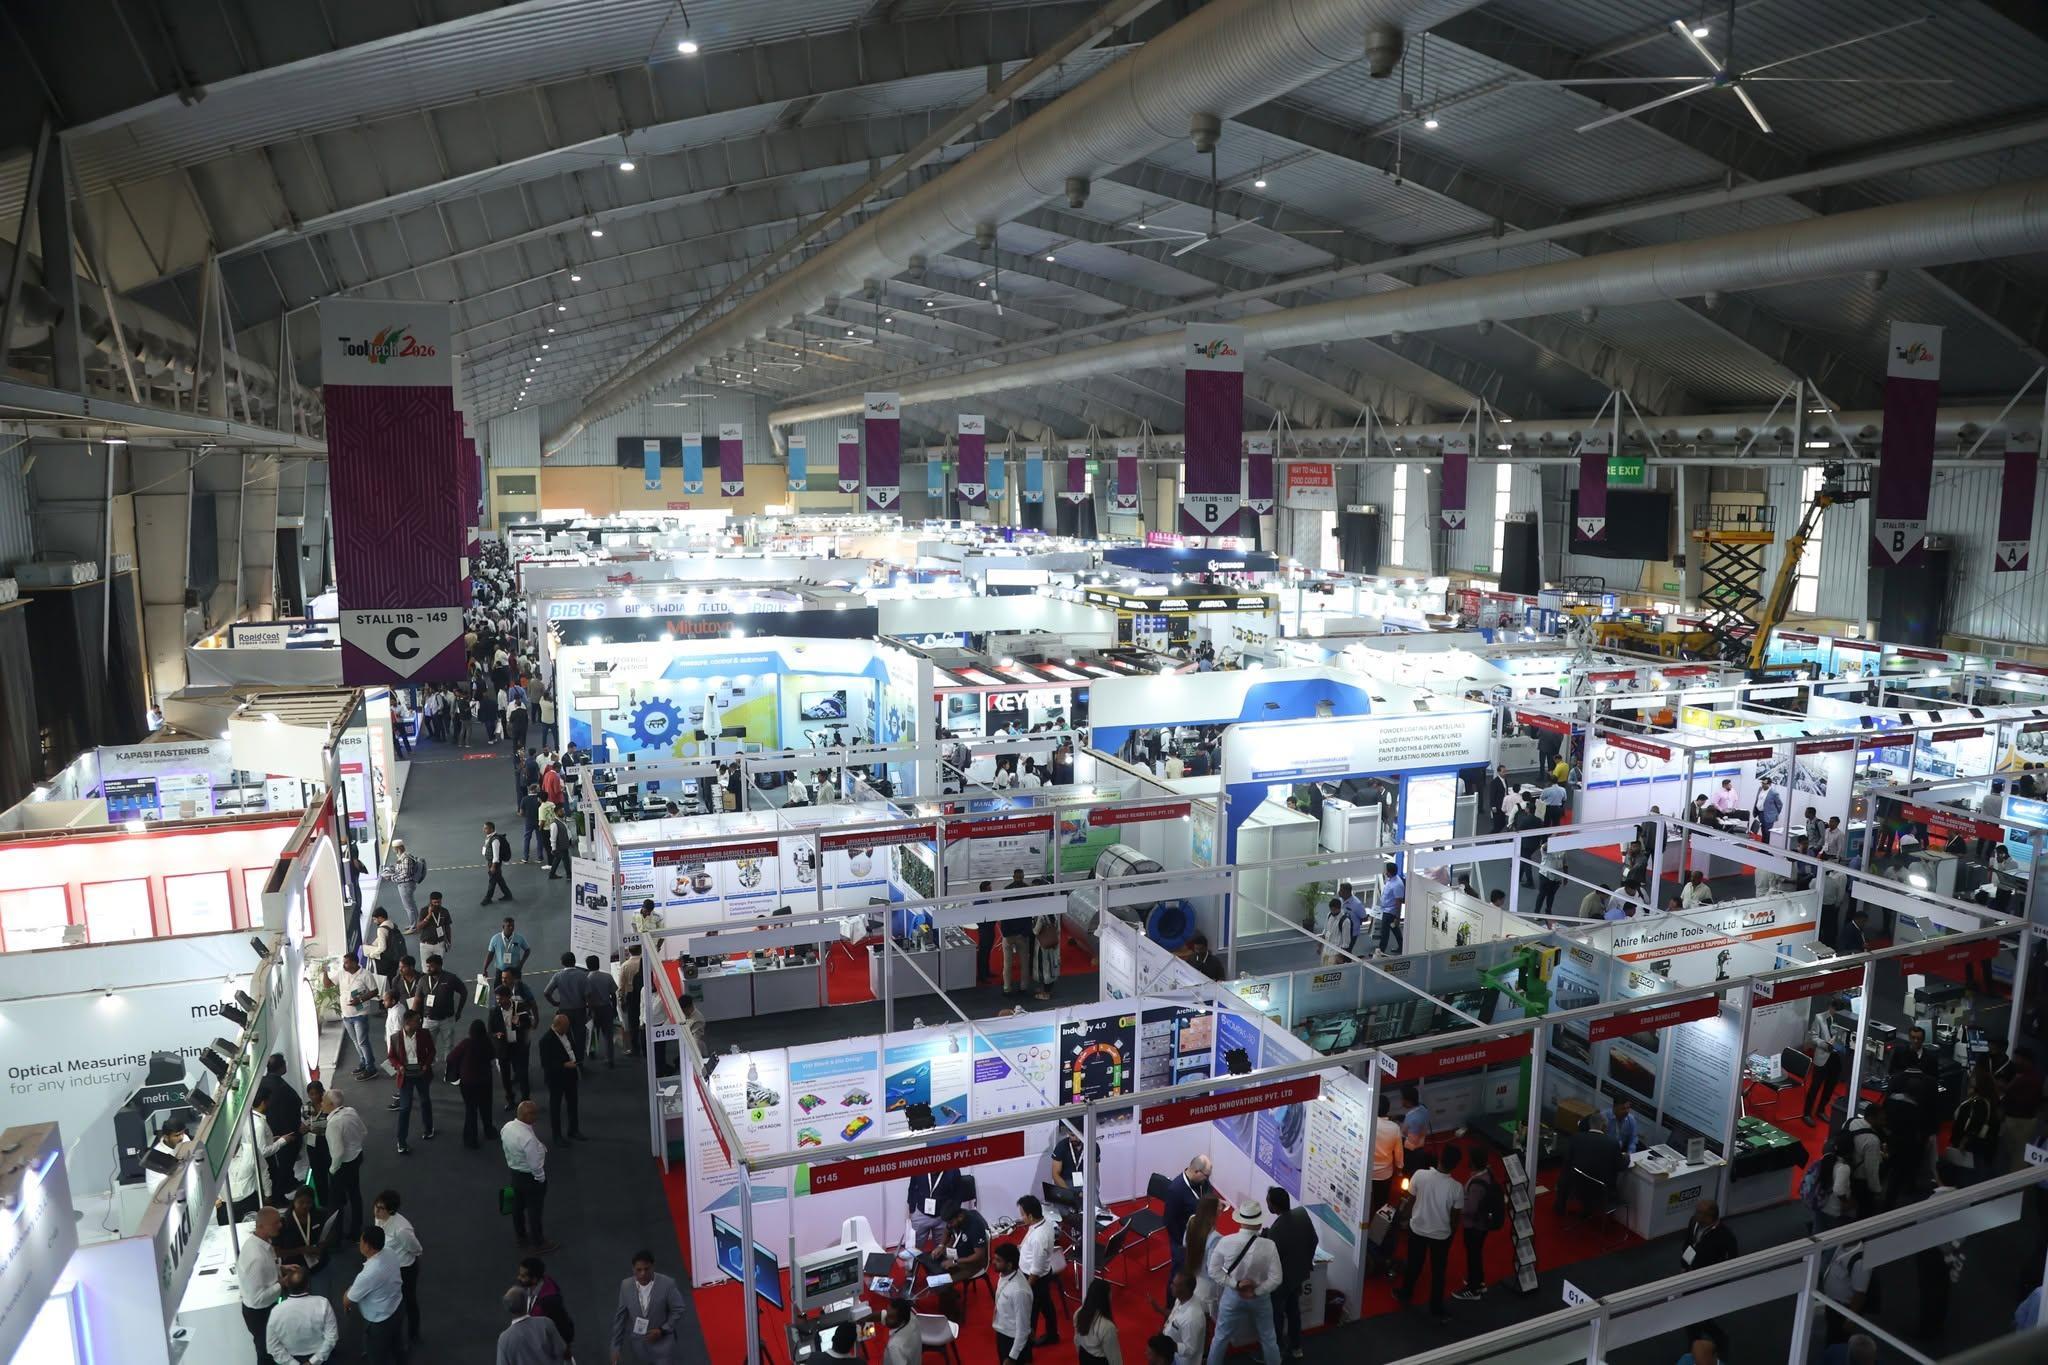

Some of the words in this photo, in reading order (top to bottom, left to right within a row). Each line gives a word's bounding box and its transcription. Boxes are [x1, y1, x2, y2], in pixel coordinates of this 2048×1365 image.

[1607, 466, 1616, 475] RE
[1618, 466, 1640, 476] EXIT
[729, 484, 736, 493] B
[879, 492, 888, 502] B
[1205, 504, 1218, 522] B
[1449, 514, 1456, 524] A
[1587, 523, 1595, 533] A
[1893, 530, 1904, 552] B
[2008, 548, 2017, 562] A
[657, 604, 685, 613] INDIA
[356, 614, 394, 625] STALL
[396, 614, 414, 624] 118
[427, 612, 448, 622] 149
[240, 632, 262, 642] Rapid
[262, 632, 280, 640] Coat
[386, 626, 420, 660] C
[987, 692, 1072, 712] KEYCE
[116, 750, 152, 760] KAPASI
[154, 747, 210, 758] FASTENERS
[1613, 938, 1638, 949] Ahire
[1641, 931, 1678, 944] Machine
[1681, 927, 1704, 937] Tools
[1650, 948, 1676, 958] PRECISION
[1676, 943, 1700, 954] DRILLING
[1706, 938, 1728, 948] TAPPING
[1458, 952, 1475, 960] ERGO
[1580, 950, 1594, 962] ERGO
[1393, 962, 1410, 971] ERGO
[1324, 973, 1341, 982] ERGO
[1638, 975, 1655, 988] ERGO
[1094, 1022, 1107, 1030] 4.0
[655, 1028, 676, 1038] C145
[1440, 1057, 1455, 1066] ERGO
[1456, 1050, 1486, 1063] HANDLERS
[8, 1062, 63, 1080] Optical
[68, 1052, 146, 1072] Measuring
[10, 1084, 32, 1095] for
[38, 1080, 65, 1093] any
[70, 1070, 131, 1088] industry
[142, 1090, 186, 1104] metrios
[1145, 1114, 1165, 1125] C145
[1190, 1104, 1218, 1116] PHAROS
[1219, 1095, 1263, 1111] INNOVATIONS
[1264, 1092, 1280, 1102] PVT.
[1281, 1089, 1293, 1098] LTD
[816, 1172, 838, 1184] C145
[864, 1162, 897, 1175] PHAROS
[899, 1153, 952, 1170] INNOVATIONS
[953, 1149, 970, 1162] PVT.
[973, 1146, 988, 1157] LTD
